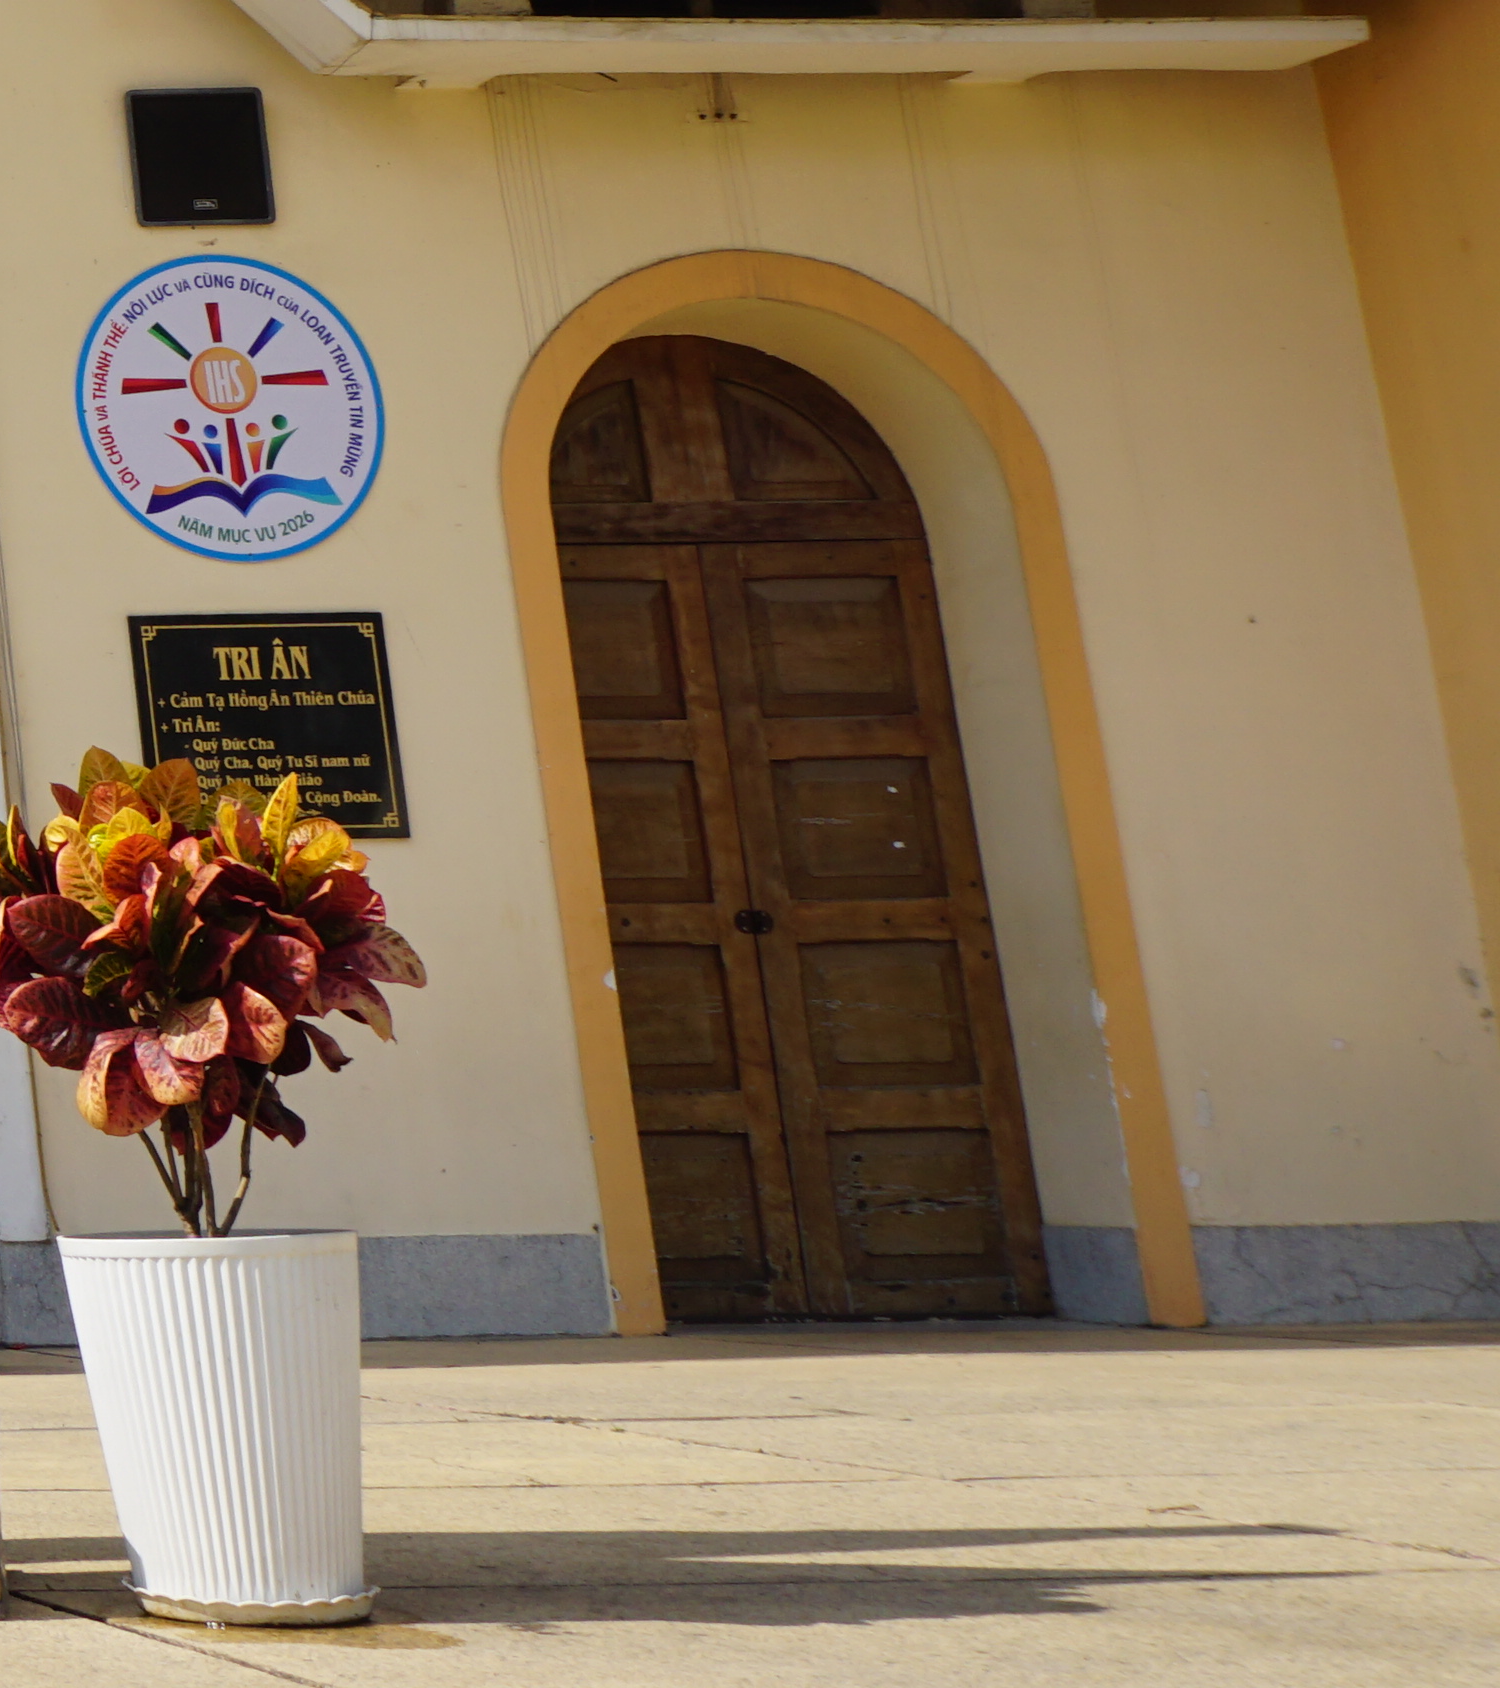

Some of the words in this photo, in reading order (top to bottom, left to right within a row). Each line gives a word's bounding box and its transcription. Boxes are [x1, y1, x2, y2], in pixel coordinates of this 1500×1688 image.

[174, 278, 192, 293] VÀ
[193, 272, 235, 289] CÙNG
[239, 277, 276, 301] ĐÍCH
[145, 283, 173, 306] LỰC
[276, 295, 299, 315] CỦA
[122, 298, 148, 324] NỘI
[299, 309, 336, 346] LOAN
[91, 350, 114, 400] THÁNH
[203, 359, 247, 404] IHS
[94, 405, 109, 421] VÀ
[349, 405, 364, 429] TIN
[98, 424, 123, 465] CHÚA
[339, 431, 364, 478] MỪNG
[117, 466, 141, 491] LỜI
[177, 514, 214, 539] NĂM
[217, 527, 252, 545] MỤC
[254, 525, 277, 542] VỤ
[277, 509, 315, 537] 2026
[212, 646, 263, 681] TRI
[271, 637, 312, 680] ÂN
[169, 691, 204, 708] Cảm
[205, 692, 226, 712] Tạ
[228, 688, 269, 711] Hồng
[269, 688, 290, 707] Ân
[292, 690, 334, 706] Thiên
[337, 689, 376, 706] Chúa
[172, 717, 194, 733] Tri
[192, 737, 218, 754] Quý
[221, 737, 248, 751] Đức
[248, 737, 275, 750] Cha
[194, 756, 220, 772] Quý
[257, 754, 283, 772] Quý
[285, 755, 303, 768] Tu
[304, 754, 319, 768] Sĩ
[321, 757, 350, 768] nam
[353, 753, 371, 767] nữ
[197, 774, 222, 790] Quý
[225, 775, 251, 787] bn
[305, 790, 341, 807] Cộng
